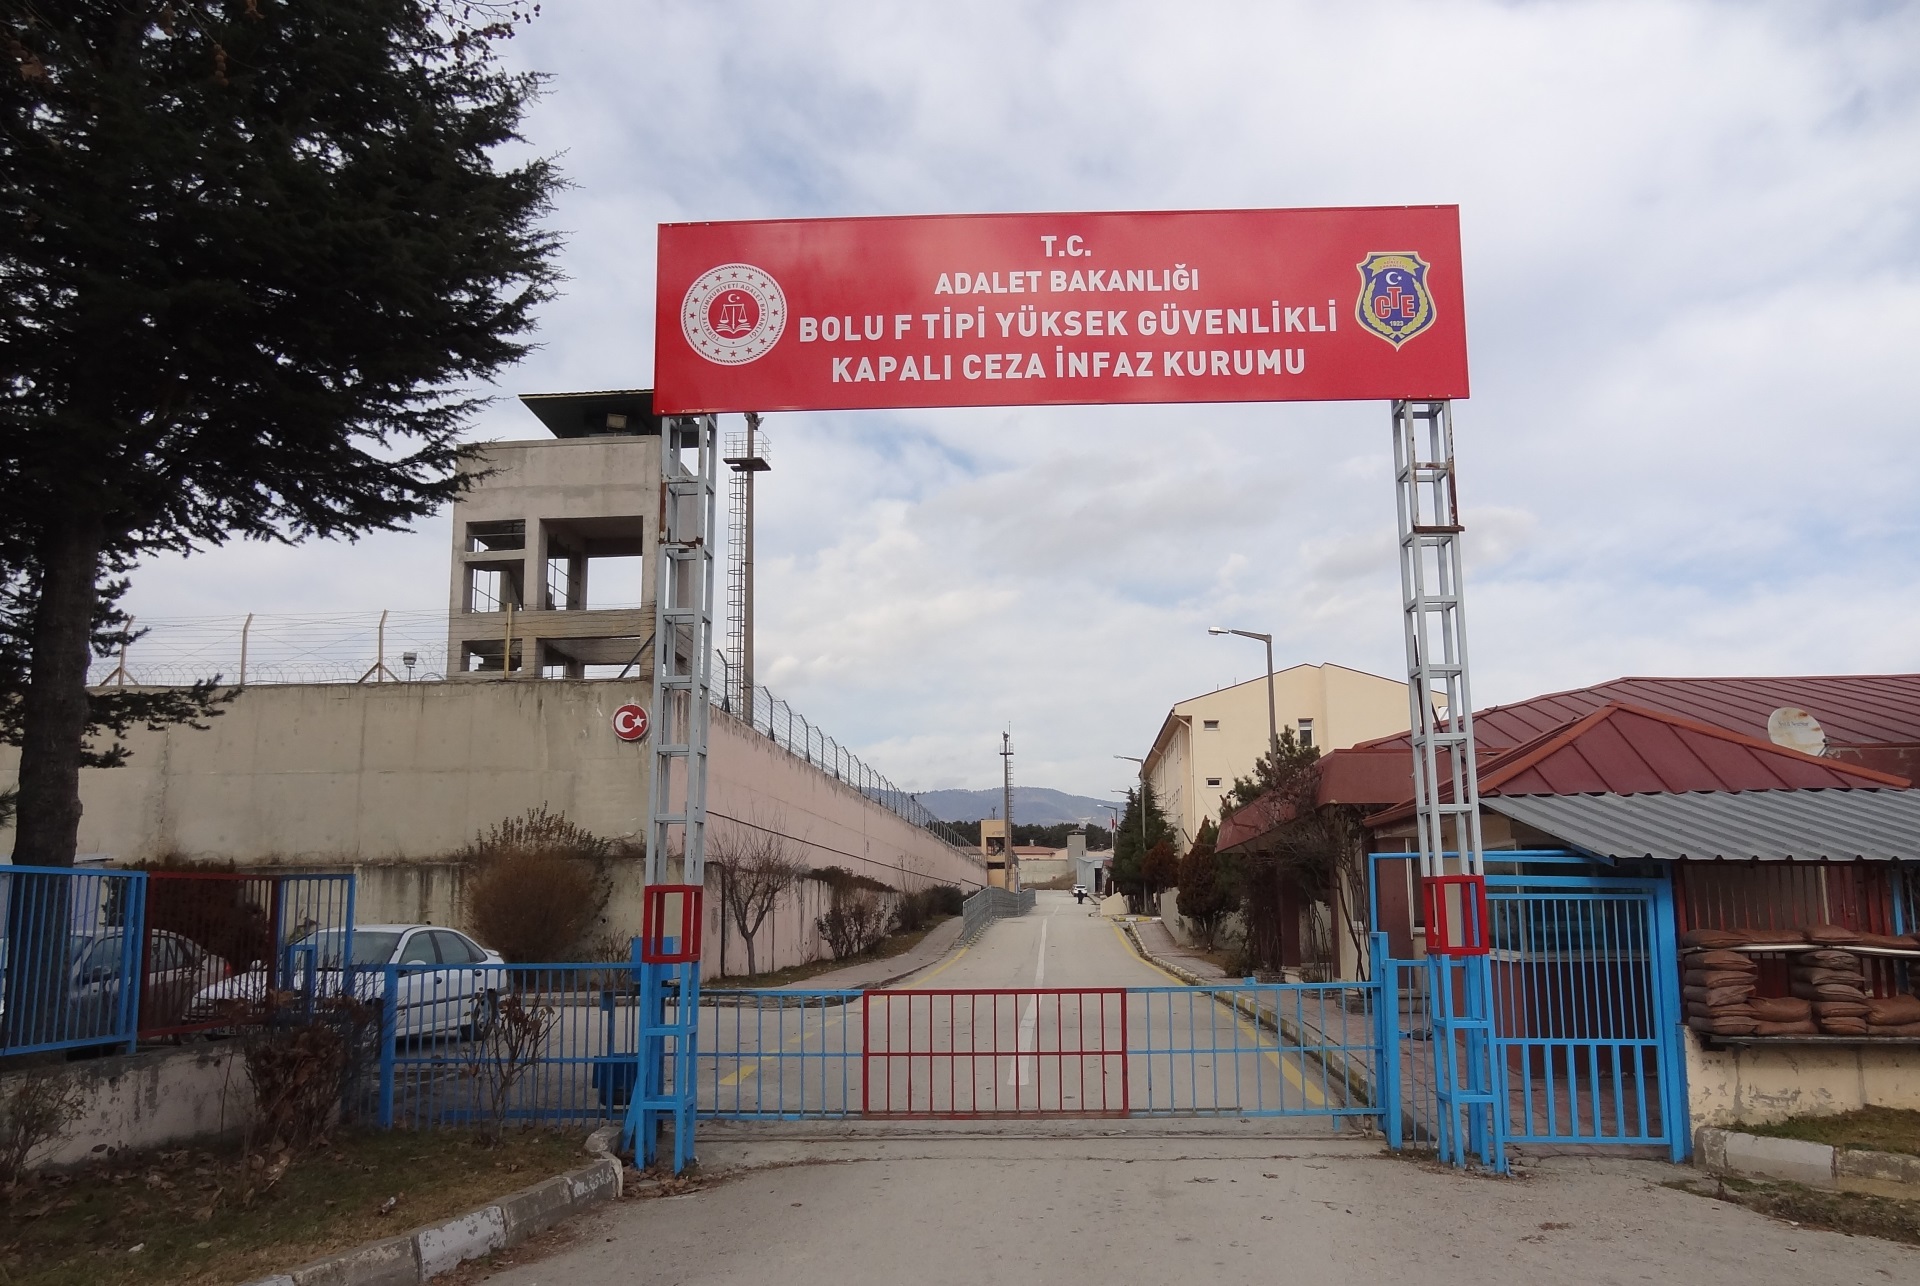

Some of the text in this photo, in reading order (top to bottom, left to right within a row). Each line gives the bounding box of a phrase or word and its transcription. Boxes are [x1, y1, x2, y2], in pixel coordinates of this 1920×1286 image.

[1041, 235, 1092, 257] T.C.
[740, 284, 763, 302] ADALET
[934, 263, 1199, 295] ADALET BAKANLIĞI
[1374, 286, 1416, 319] CTE
[799, 299, 1337, 343] BOLU F TİPİ YÜKSEK GÜVENLİKLİ
[832, 345, 1305, 383] KAPALI CEZA İNFAZ KURUMU
